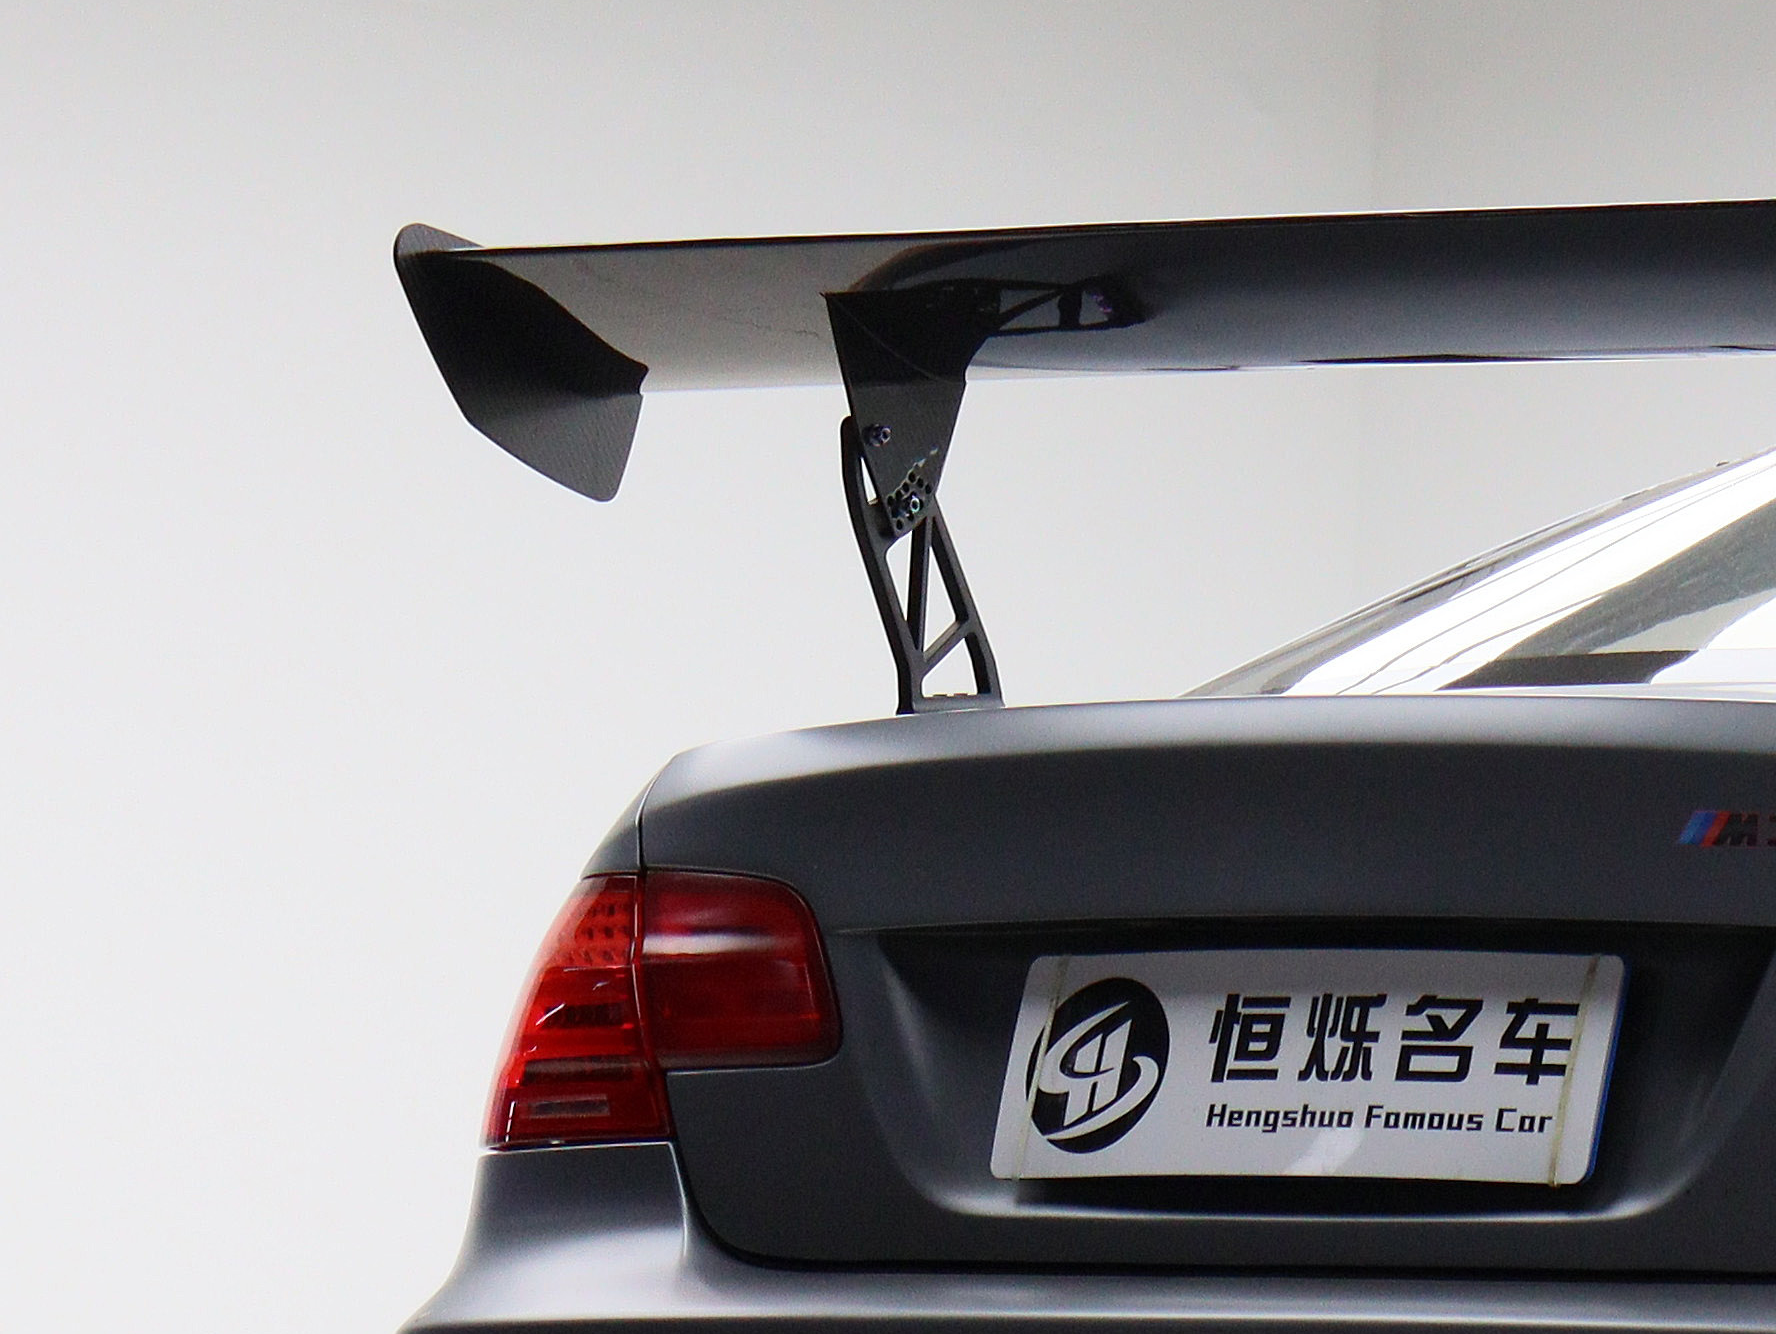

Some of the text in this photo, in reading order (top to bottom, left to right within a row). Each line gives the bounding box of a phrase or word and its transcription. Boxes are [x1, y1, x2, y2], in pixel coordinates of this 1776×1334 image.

[1208, 993, 1580, 1085] 恒烁名车
[1206, 1103, 1553, 1133] Hengshuo Famous Car
